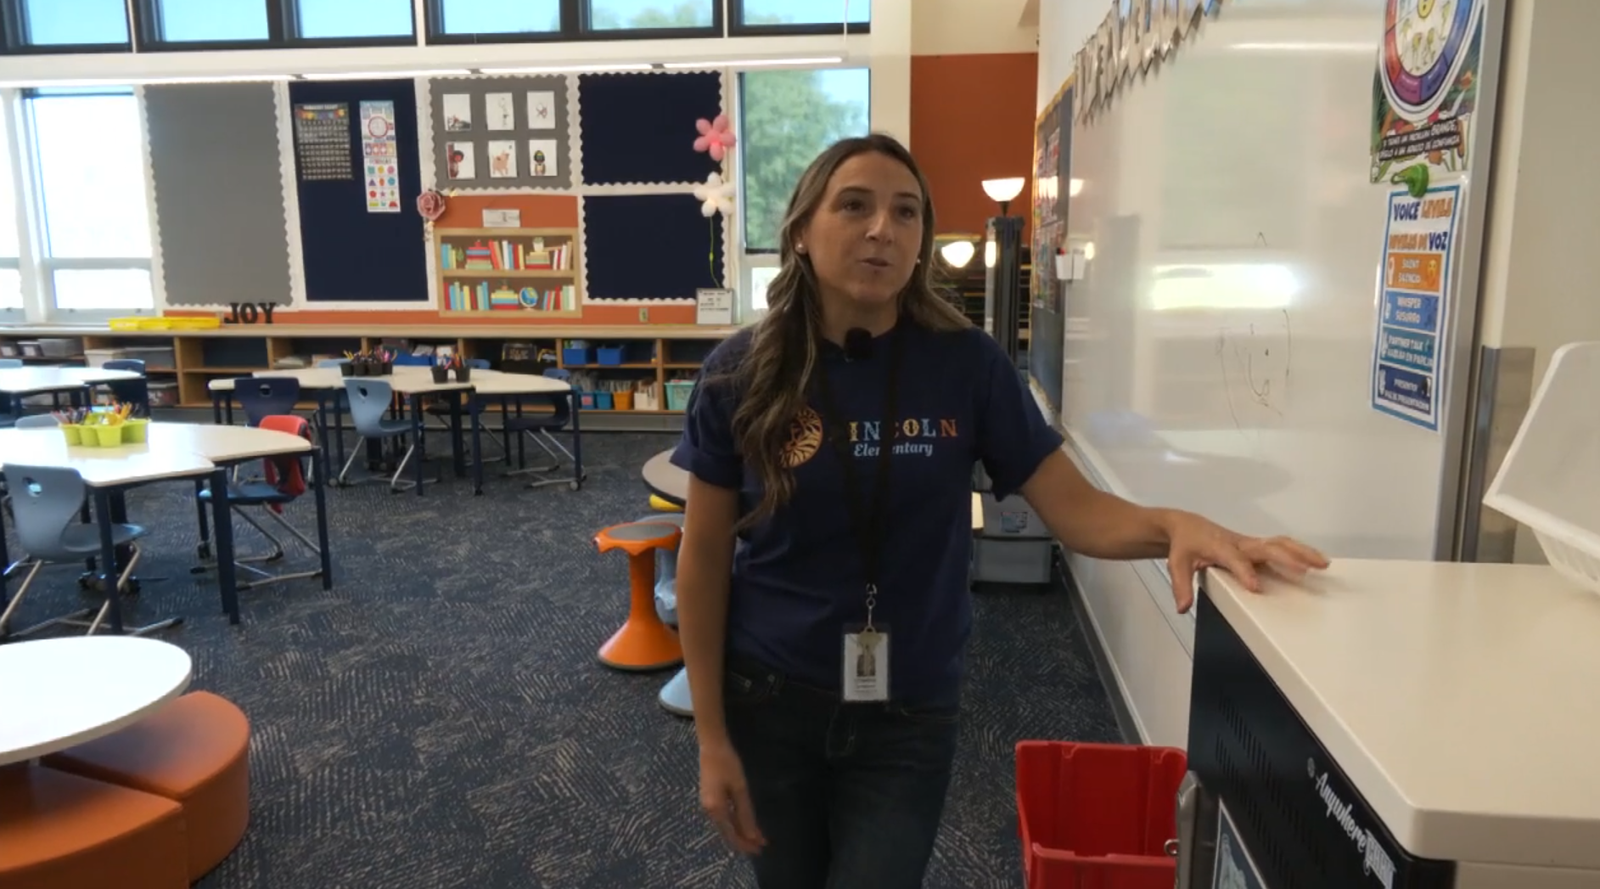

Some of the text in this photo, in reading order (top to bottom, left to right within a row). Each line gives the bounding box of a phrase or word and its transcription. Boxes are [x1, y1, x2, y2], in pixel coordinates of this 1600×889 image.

[1393, 202, 1421, 221] VOICE
[1429, 232, 1448, 251] VOZ
[224, 302, 276, 324] JOY
[853, 441, 934, 458] Elentary
